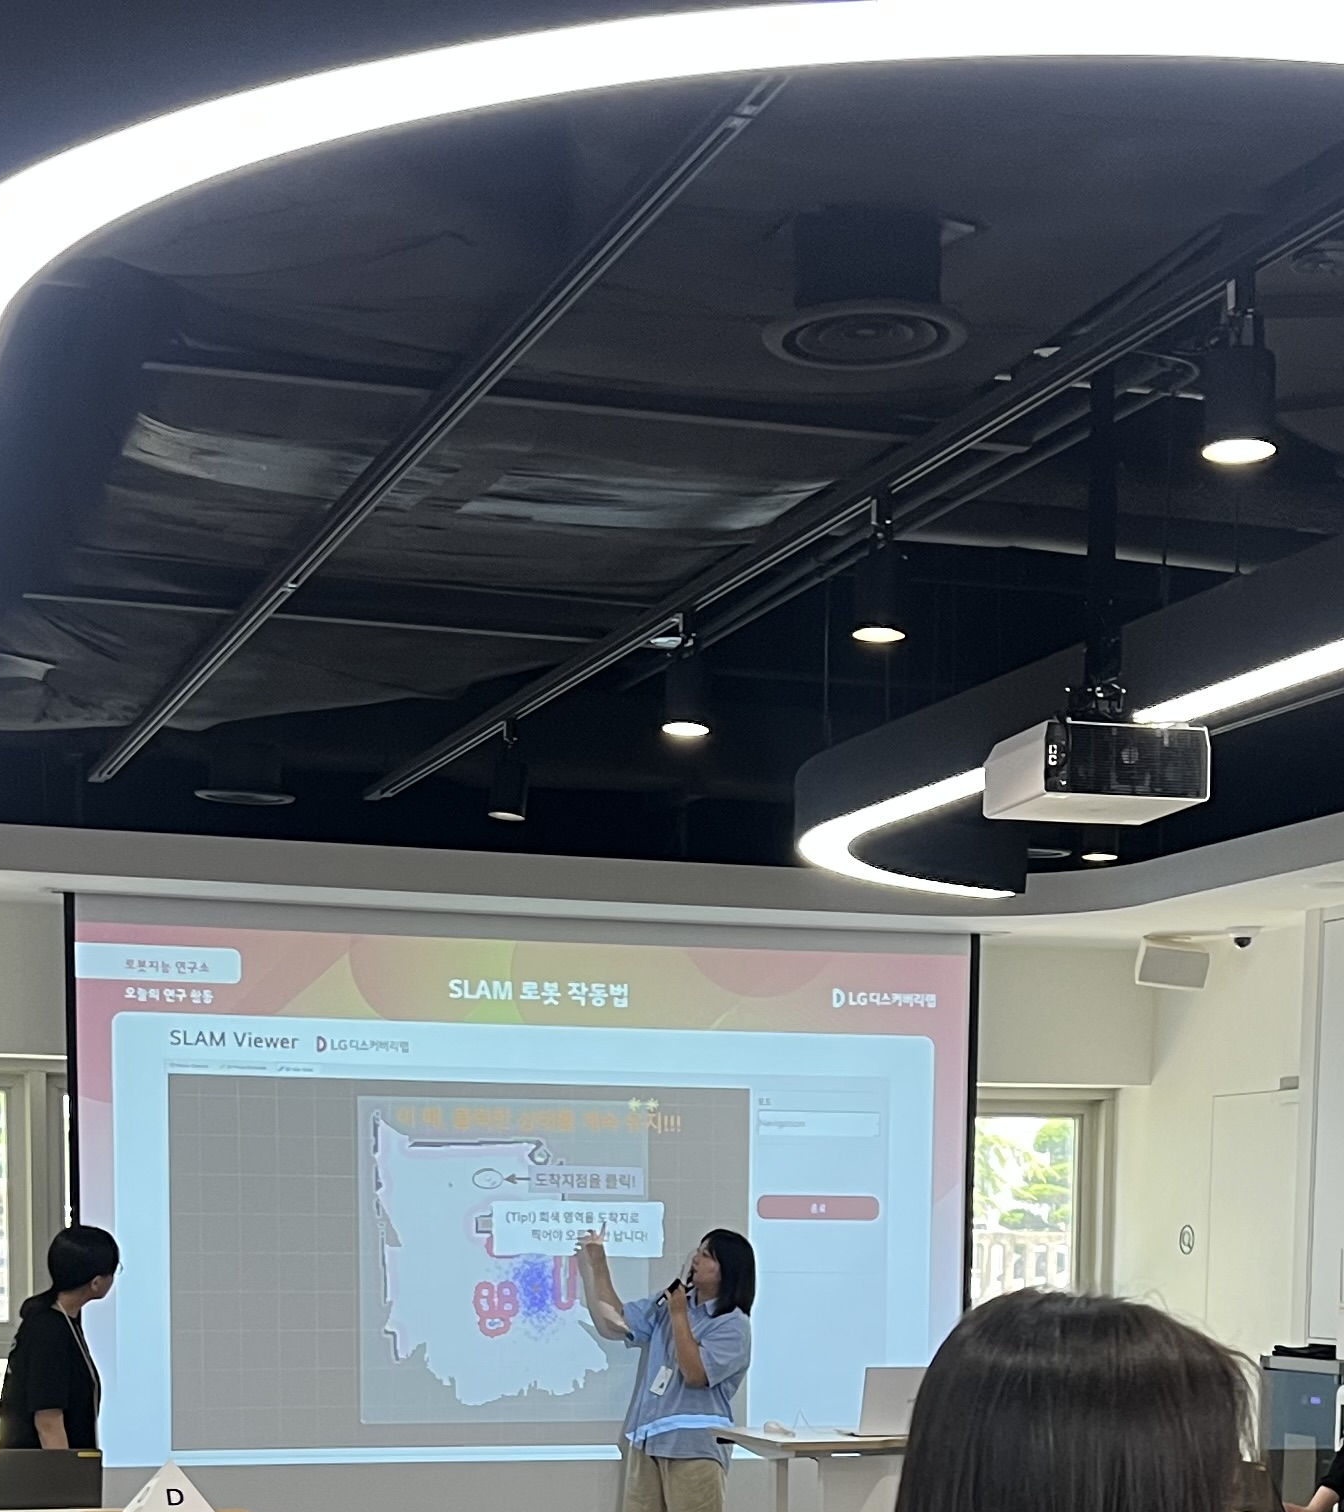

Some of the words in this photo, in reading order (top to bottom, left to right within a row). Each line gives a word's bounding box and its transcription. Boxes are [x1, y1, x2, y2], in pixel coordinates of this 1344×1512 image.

[124, 958, 171, 974] 로봇지능
[175, 960, 210, 974] 연구소
[123, 986, 160, 1002] 오늘의
[163, 987, 188, 1003] 연구
[448, 979, 513, 1001] SLAM
[519, 981, 562, 1006] 로봇
[567, 982, 629, 1008] 작동법
[169, 1029, 226, 1048] SLAM
[234, 1030, 300, 1049] Viewer
[535, 1173, 602, 1190] 도착지점을
[606, 1174, 636, 1190] 클릭!
[506, 1211, 537, 1224] (Tip!)
[563, 1212, 594, 1224] 영역을
[598, 1212, 640, 1224] 도착지로
[166, 1488, 184, 1506] D
